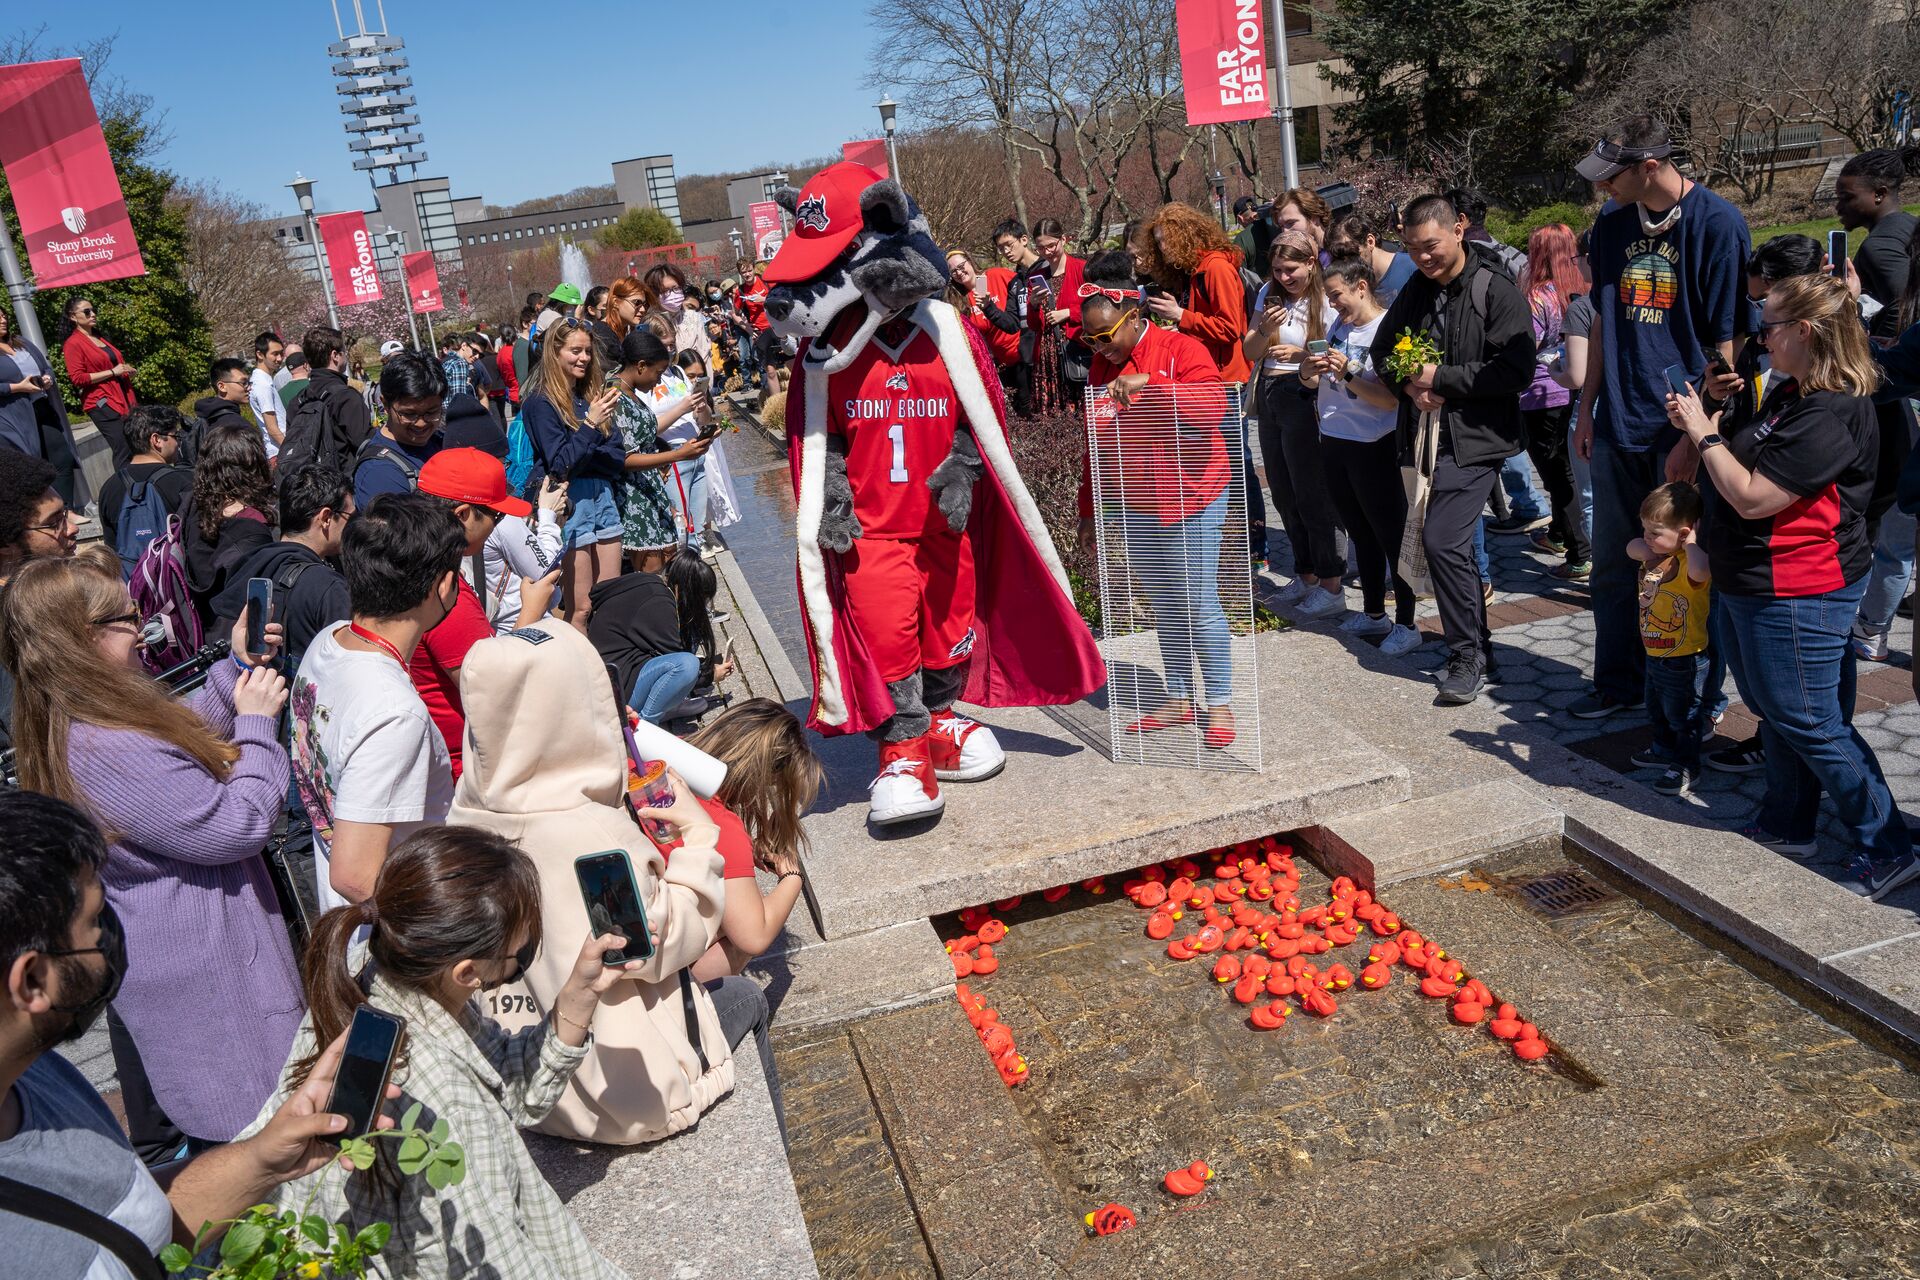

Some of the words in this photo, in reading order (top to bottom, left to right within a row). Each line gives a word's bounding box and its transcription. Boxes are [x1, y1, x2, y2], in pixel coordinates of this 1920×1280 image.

[1236, 0, 1265, 103] BEYON
[1217, 48, 1243, 106] FAR
[47, 241, 80, 253] Stony
[80, 233, 116, 248] Brook
[1625, 239, 1656, 260] BEST
[1657, 241, 1680, 265] DAD
[55, 248, 114, 265] University
[353, 229, 379, 294] BEYOND
[350, 266, 367, 296] FAR
[1626, 306, 1637, 320] BY
[1639, 307, 1663, 324] PAR
[846, 399, 892, 418] STONY
[898, 398, 949, 418] BROOK
[888, 424, 909, 483] 1
[488, 994, 537, 1014] 1978
